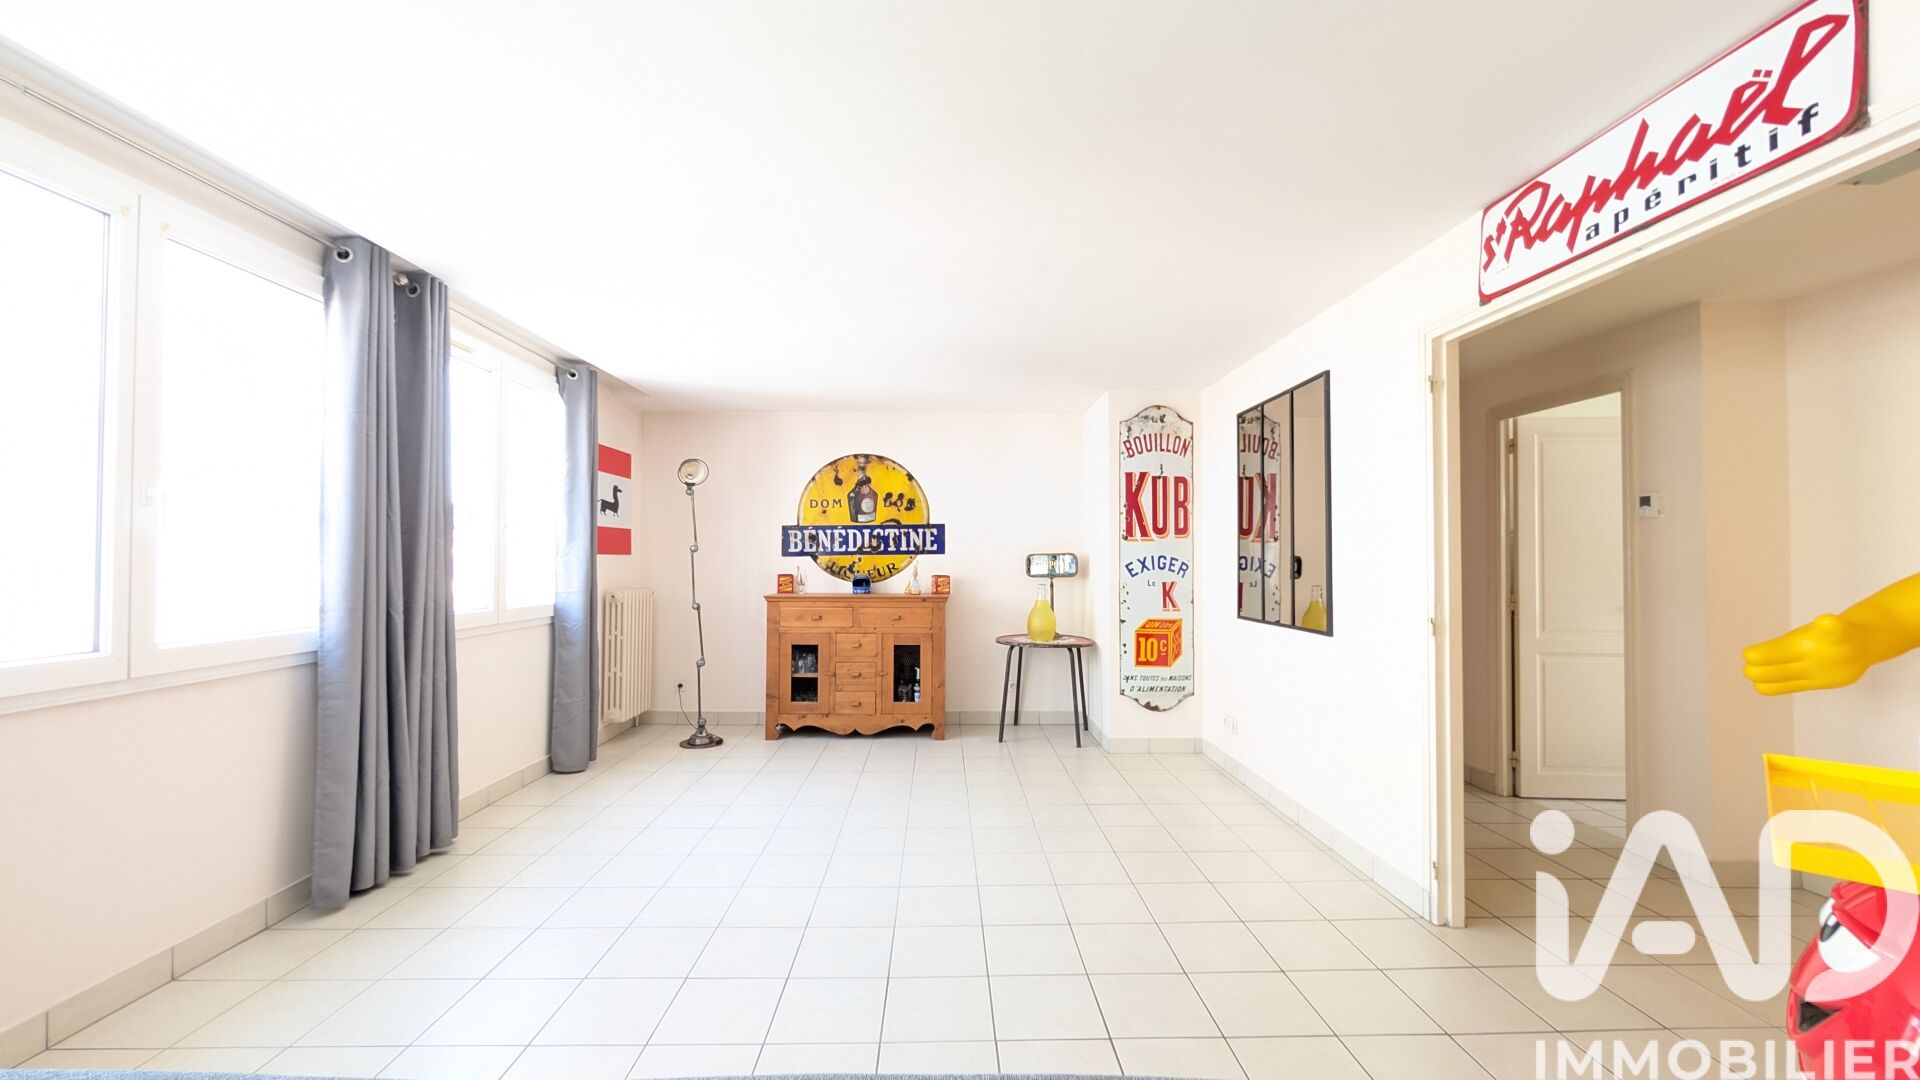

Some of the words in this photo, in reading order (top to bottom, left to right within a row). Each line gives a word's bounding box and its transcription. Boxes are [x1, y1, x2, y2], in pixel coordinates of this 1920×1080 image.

[1504, 14, 1850, 264] Raphaël
[1585, 102, 1819, 242] apéritif
[1123, 433, 1191, 458] BOUILLON
[810, 499, 842, 509] DOM
[1125, 471, 1190, 542] KUB
[788, 525, 938, 553] BÉNÉDICTINE
[1125, 555, 1189, 578] EXIGER
[1129, 685, 1186, 693] D'ALIMENTATION
